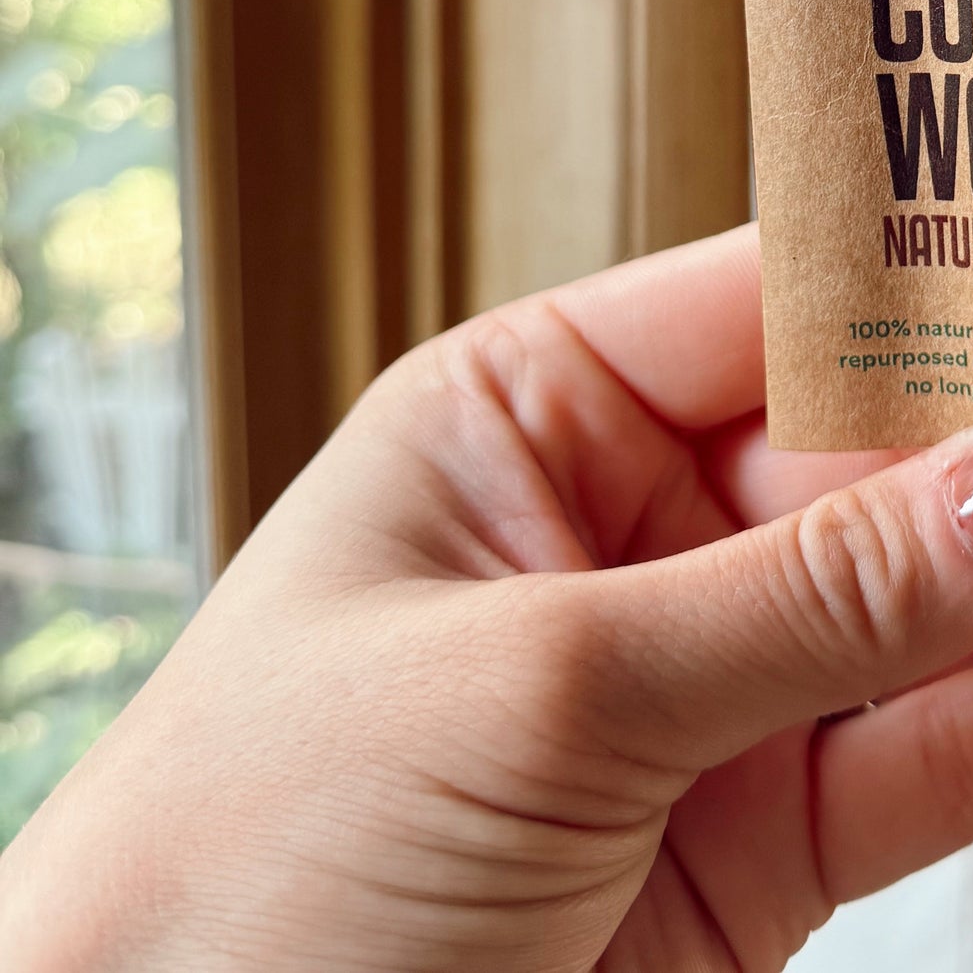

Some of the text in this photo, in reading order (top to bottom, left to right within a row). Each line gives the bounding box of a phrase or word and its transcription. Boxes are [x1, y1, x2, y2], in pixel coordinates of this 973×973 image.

[849, 320, 911, 340] 100%
[839, 350, 968, 372] repurposed
[905, 379, 933, 395] no
